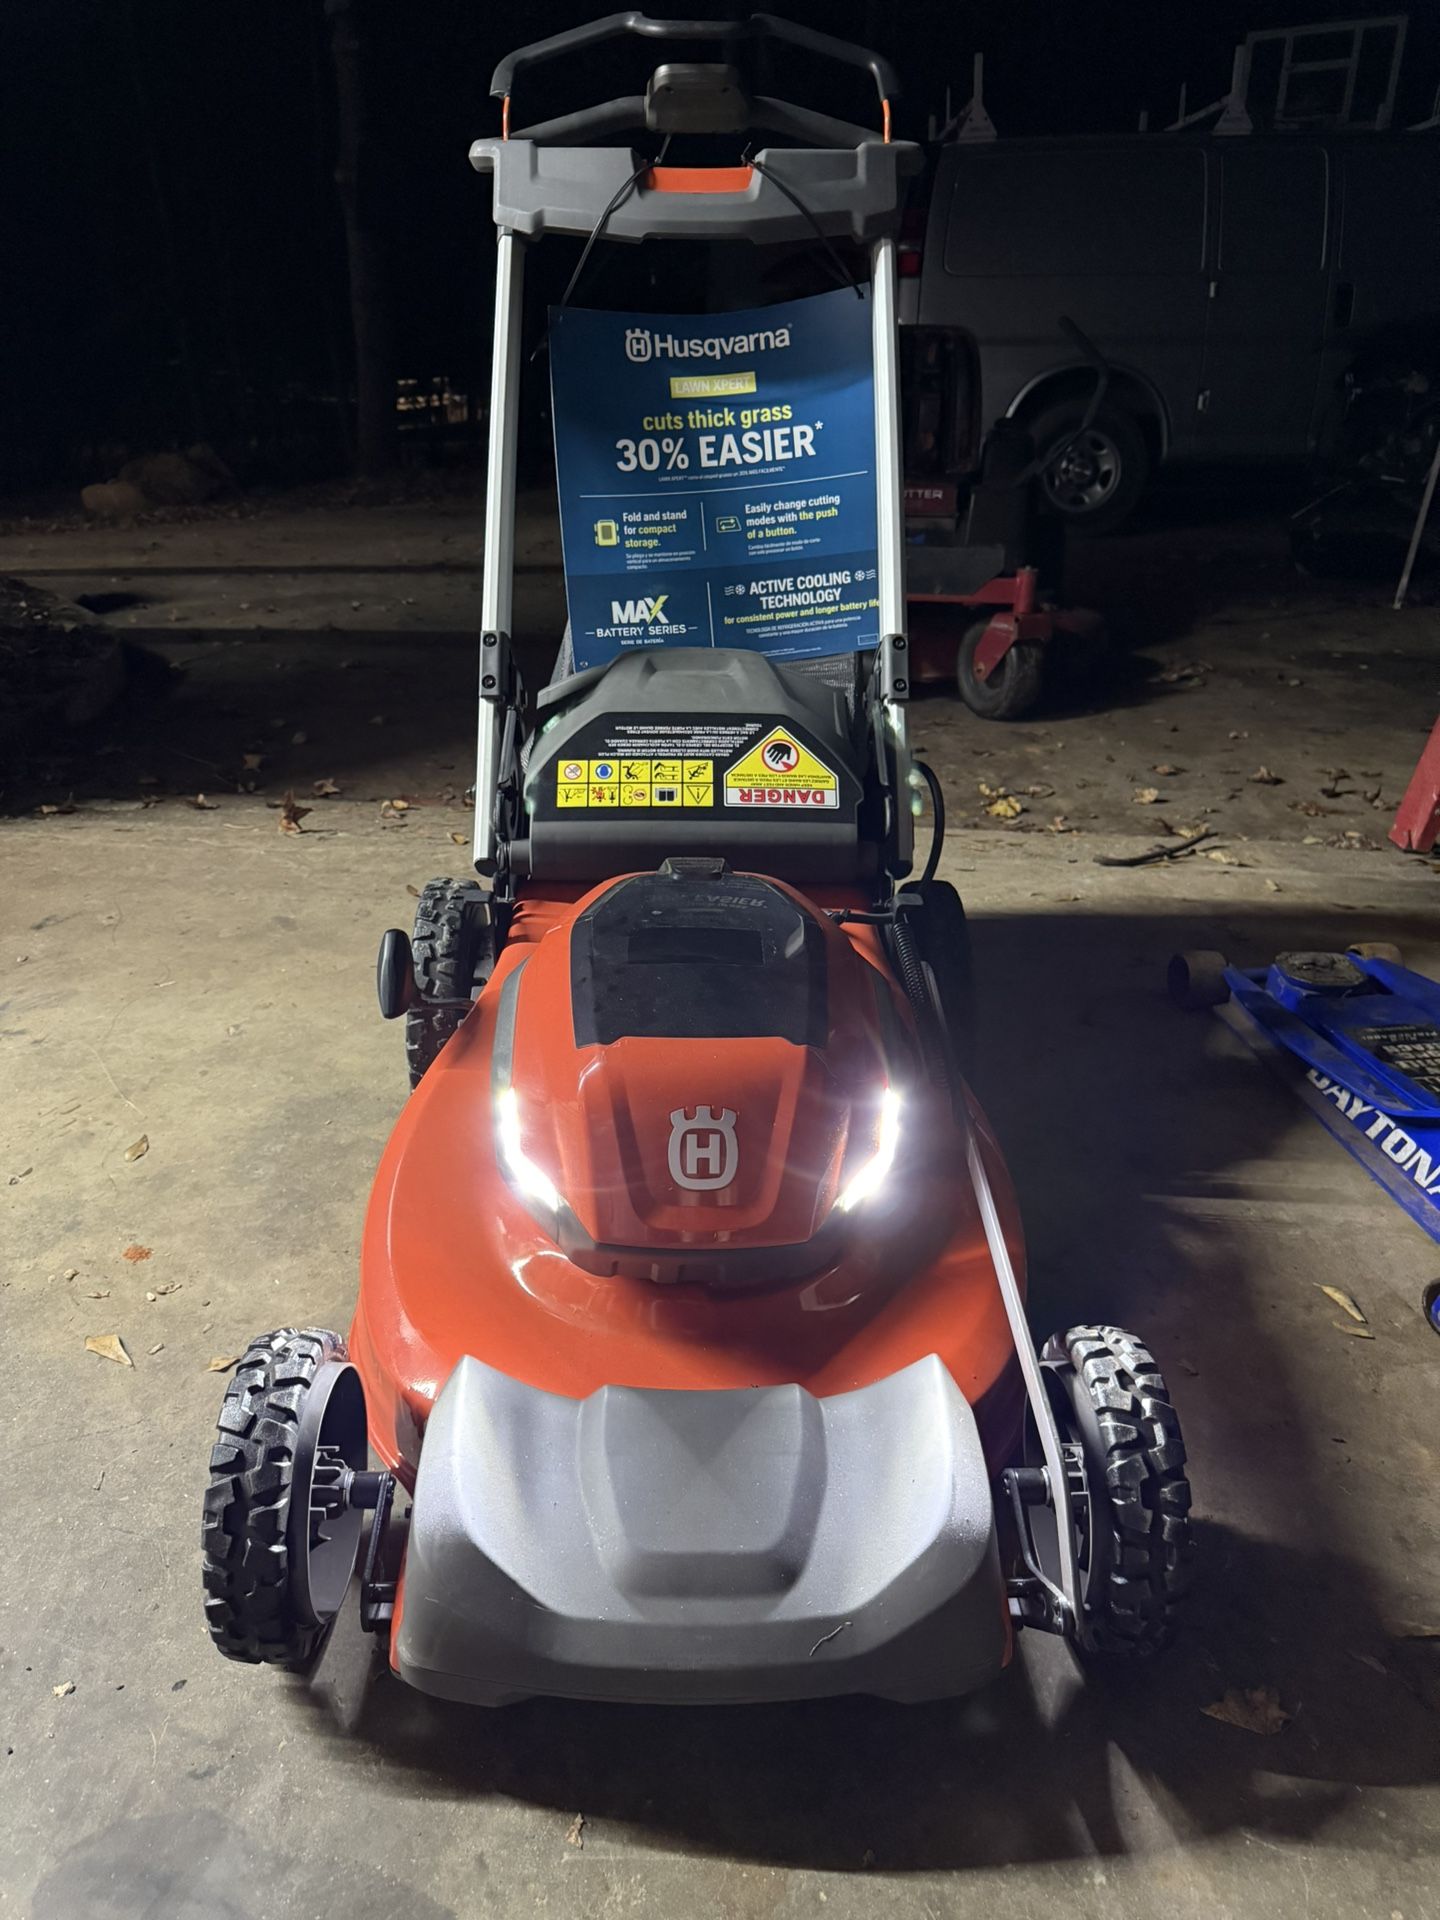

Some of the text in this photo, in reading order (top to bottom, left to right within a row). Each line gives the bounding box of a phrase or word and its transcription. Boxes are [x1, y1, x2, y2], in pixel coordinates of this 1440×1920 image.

[654, 328, 791, 360] Husqvarna
[674, 376, 750, 394] LAWN XPERT
[643, 404, 793, 431] cuts thick grass
[615, 437, 689, 472] 30%
[745, 495, 840, 514] Easily change cutting
[622, 509, 687, 522] Fold and stand
[746, 507, 838, 527] modes with the push
[624, 524, 676, 536] for compact
[747, 527, 797, 539] of a button.
[624, 538, 661, 549] storage.
[749, 570, 851, 595] ACTIVE COOLING
[760, 587, 842, 610] TECHNOLOGY
[611, 594, 670, 624] MAX
[724, 616, 735, 625] for
[736, 612, 774, 624] consistent
[775, 609, 798, 621] power
[800, 607, 814, 617] and
[815, 604, 839, 616] longer
[840, 600, 867, 612] battery
[596, 624, 687, 638] BATTERY SERIES
[738, 788, 825, 804] DANGER
